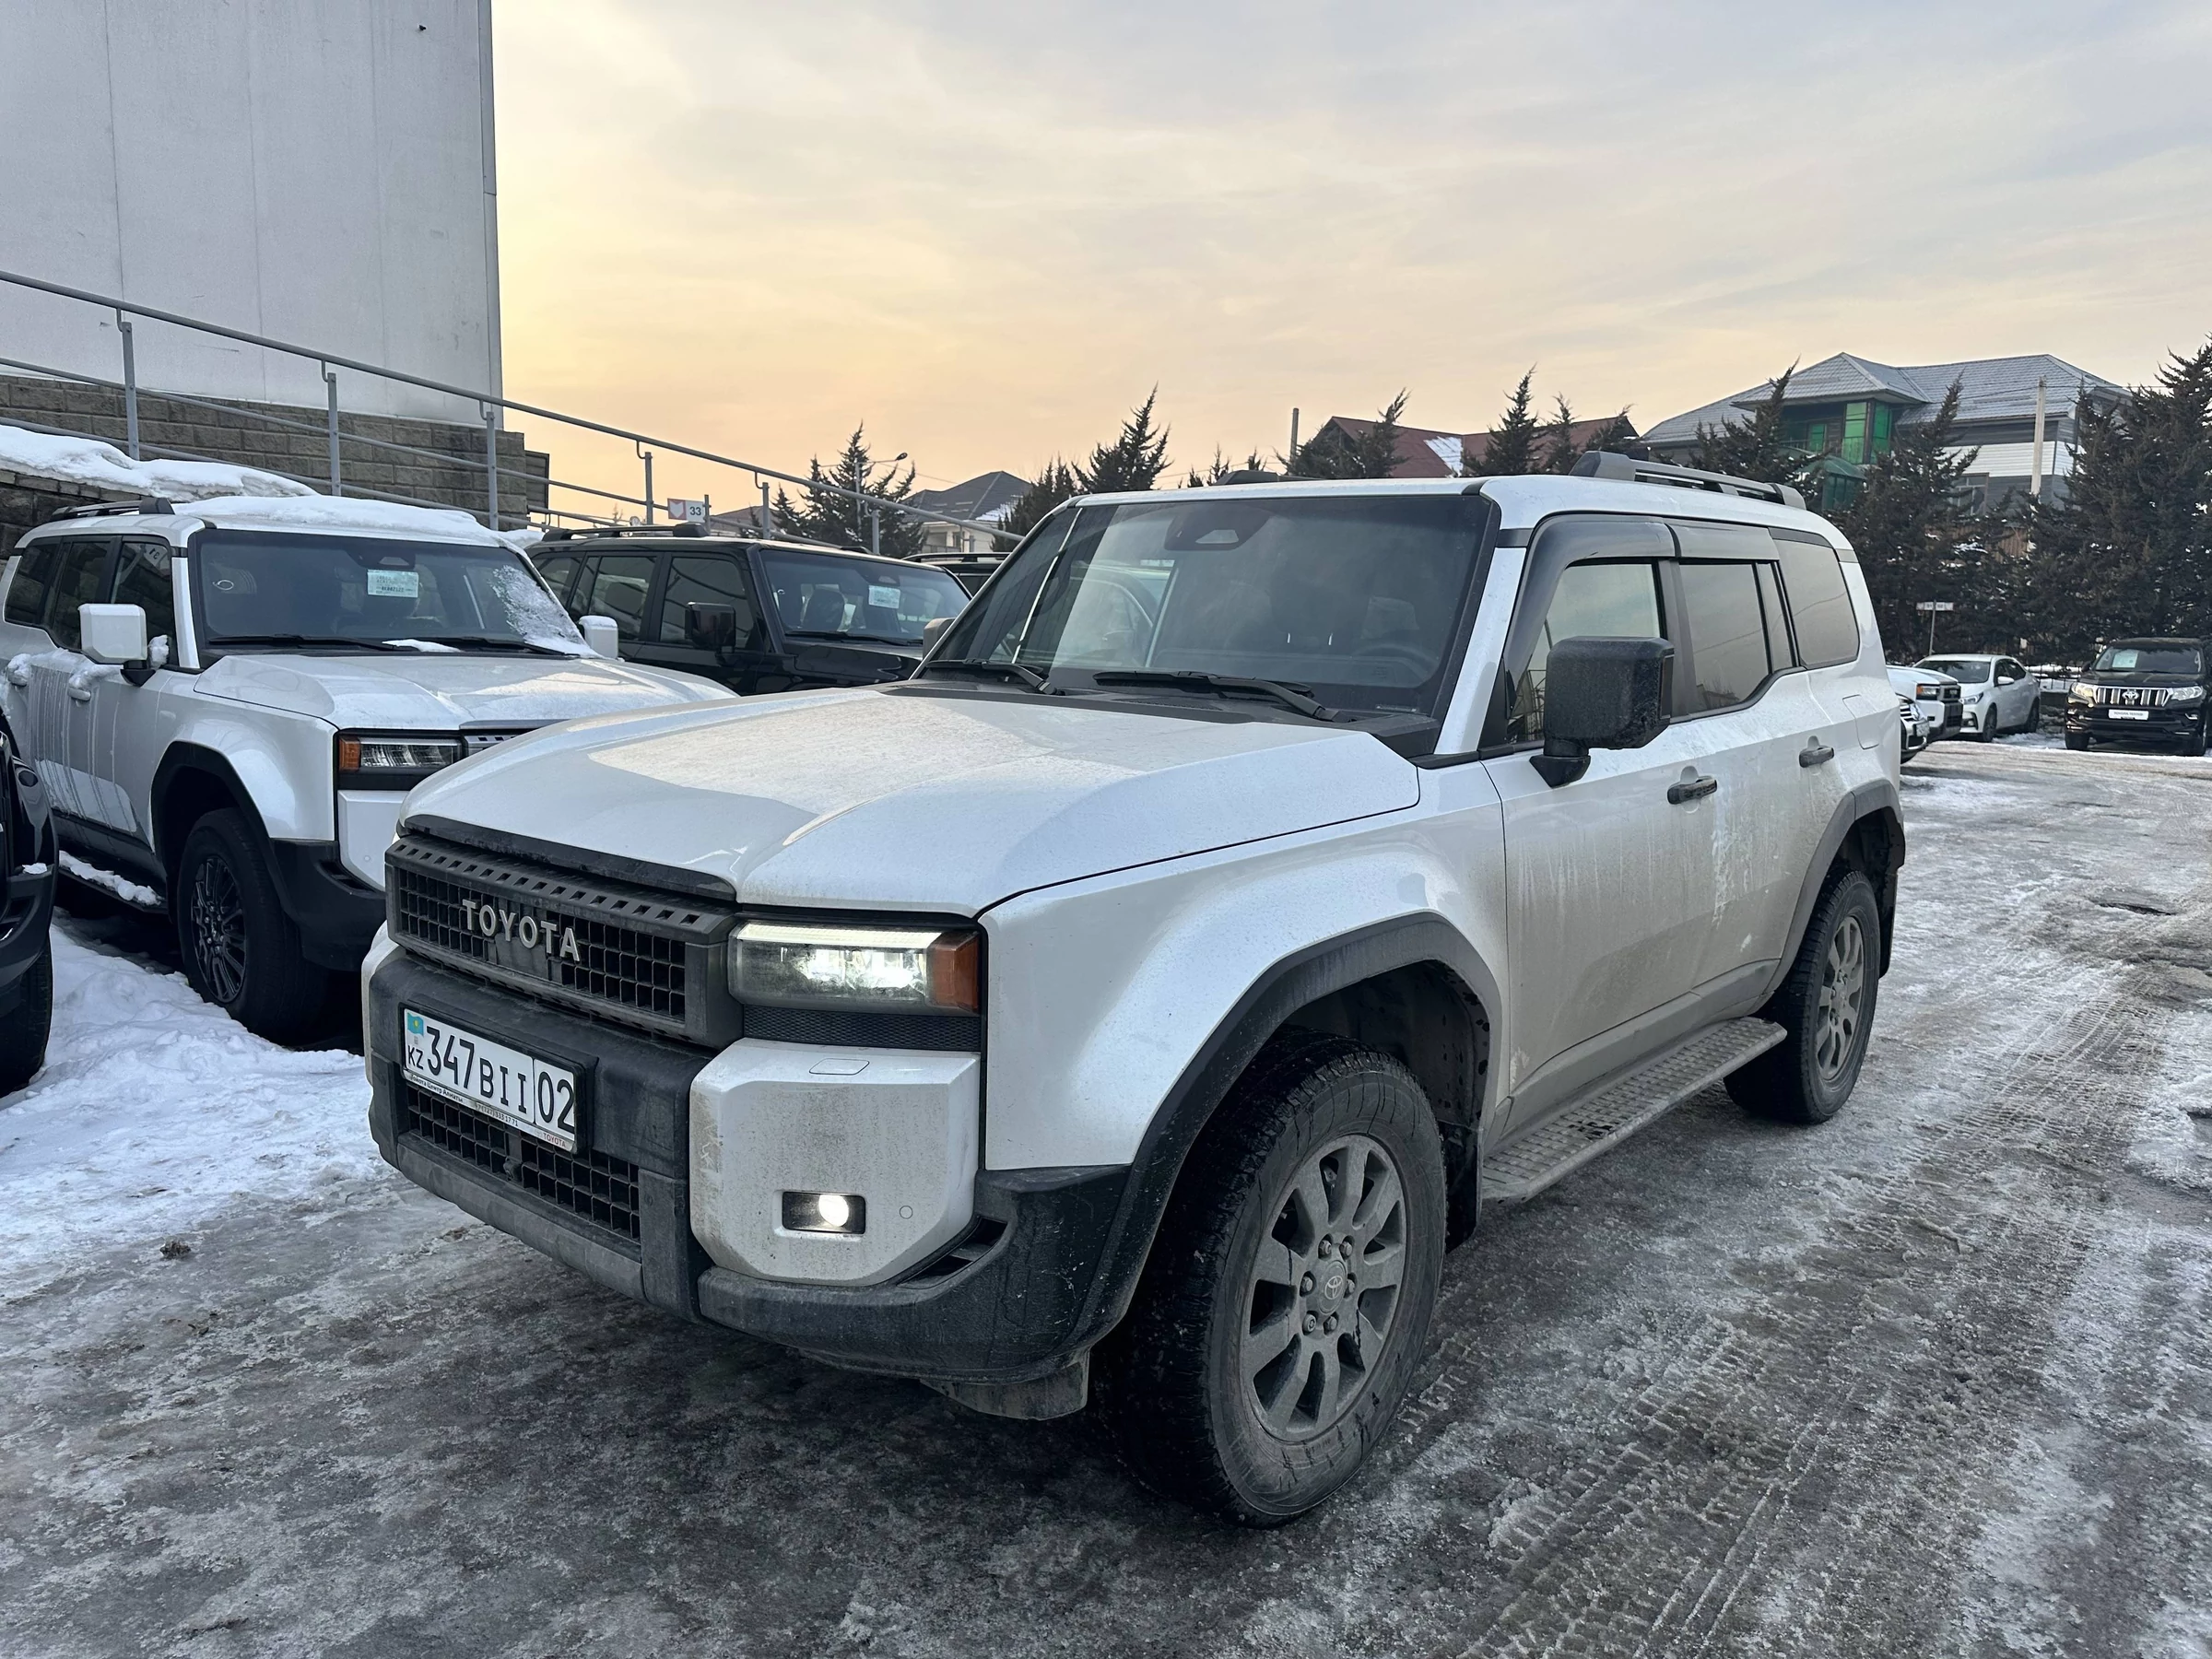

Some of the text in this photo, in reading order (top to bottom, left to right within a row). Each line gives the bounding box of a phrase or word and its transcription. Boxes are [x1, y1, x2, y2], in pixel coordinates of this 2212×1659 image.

[689, 506, 702, 516] 33
[463, 899, 581, 962] TOYOTA
[407, 1044, 424, 1070] KZ
[543, 1132, 567, 1147] TOYOTA
